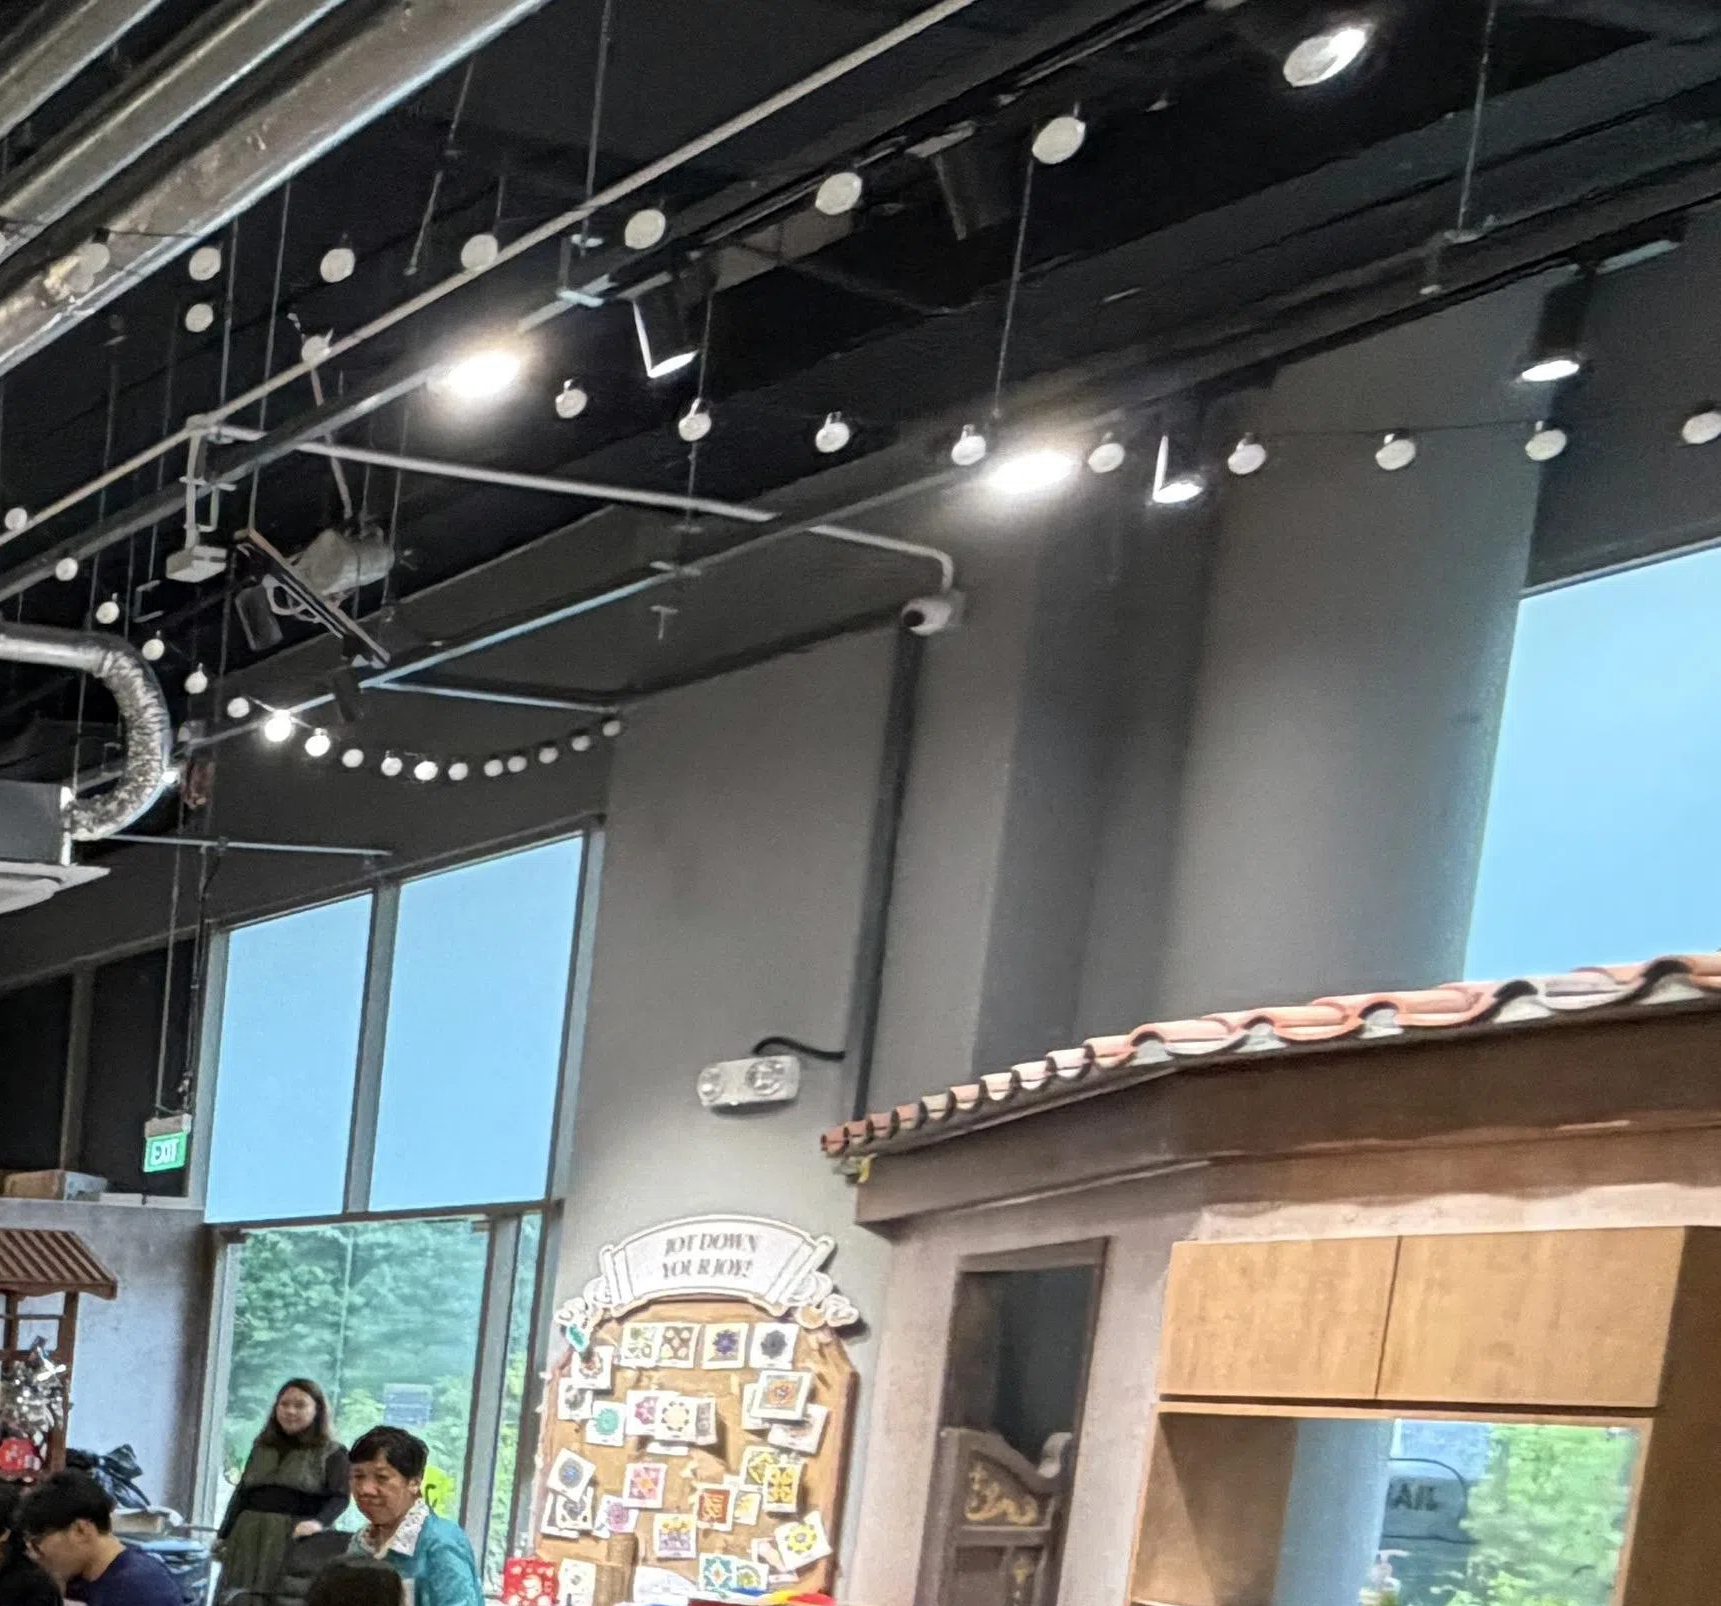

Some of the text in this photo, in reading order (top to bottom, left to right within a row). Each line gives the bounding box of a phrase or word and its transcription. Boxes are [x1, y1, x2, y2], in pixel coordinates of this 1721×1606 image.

[664, 1232, 760, 1257] JOT DOWN
[662, 1258, 710, 1279] YOUR
